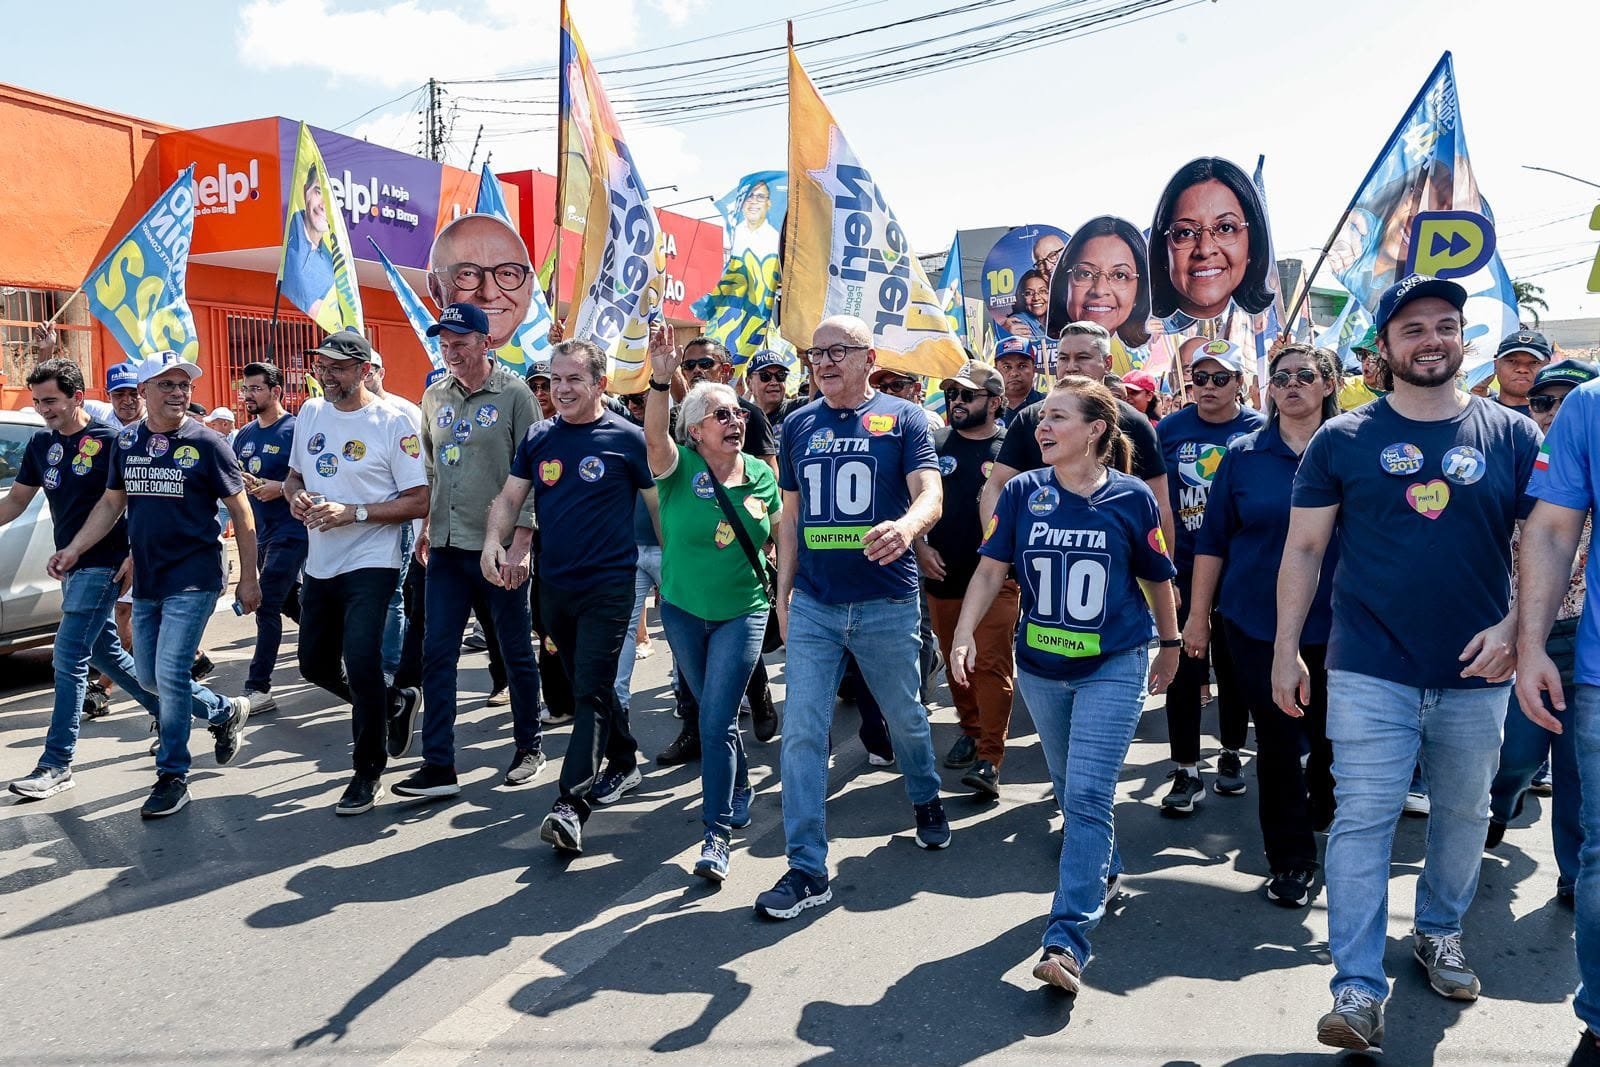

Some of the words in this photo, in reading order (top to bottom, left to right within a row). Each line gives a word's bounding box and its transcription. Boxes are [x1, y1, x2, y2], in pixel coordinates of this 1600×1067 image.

[328, 169, 379, 224] elp!
[381, 183, 390, 197] A
[390, 184, 410, 202] loja
[381, 205, 396, 219] do
[396, 208, 419, 226] Bmg
[986, 268, 1014, 296] 10
[440, 313, 463, 321] ELLER
[123, 467, 148, 480] MATO
[1389, 460, 1420, 473] 2011
[124, 480, 150, 493] CONTE
[150, 481, 184, 495] COMIGO!
[803, 461, 872, 516] 10
[1179, 484, 1208, 511] MA
[1181, 514, 1205, 532] GRO
[810, 533, 860, 543] CONFIRMA
[1028, 522, 1107, 549] PIVETTA
[1031, 557, 1107, 621] 10
[1037, 633, 1085, 651] CONFIRMA
